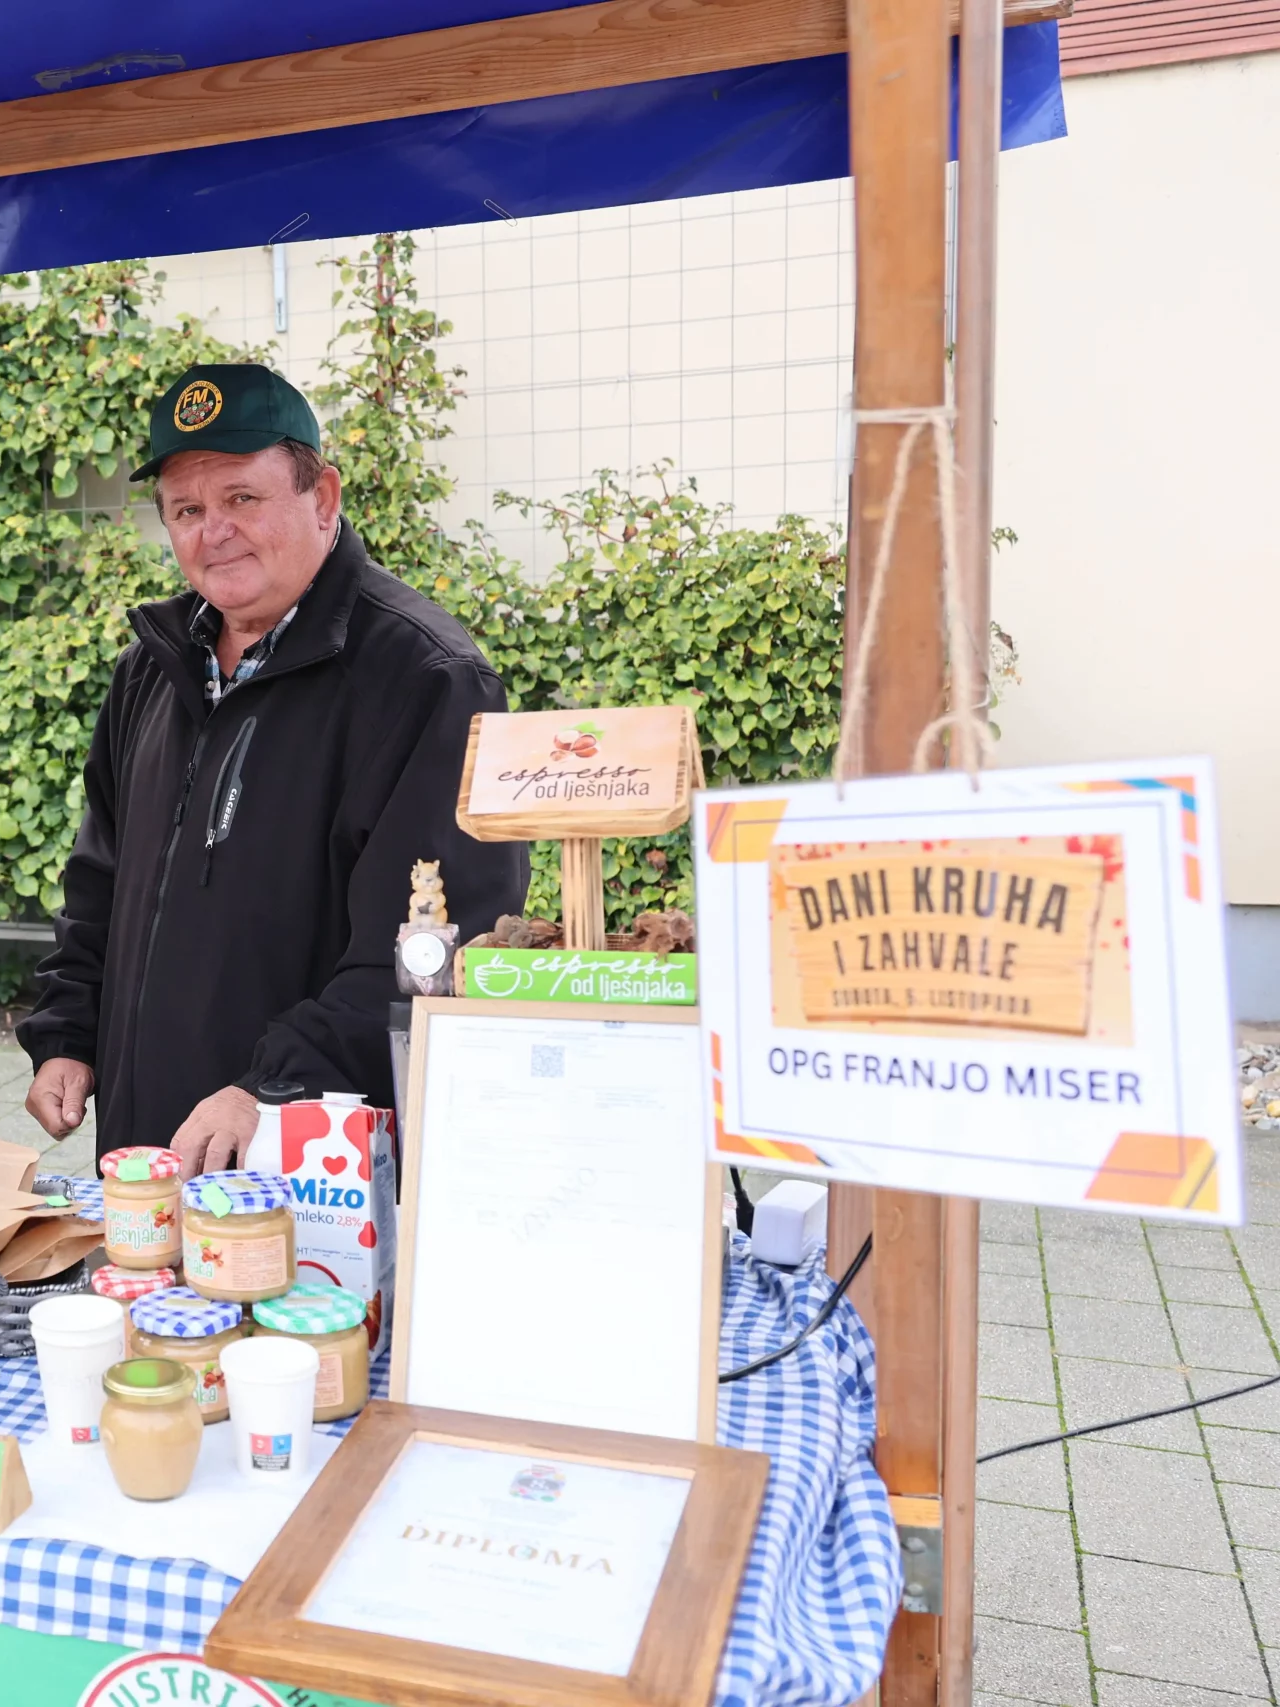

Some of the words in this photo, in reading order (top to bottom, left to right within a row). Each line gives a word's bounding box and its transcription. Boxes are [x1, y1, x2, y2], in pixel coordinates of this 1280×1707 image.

[182, 388, 209, 409] FM
[498, 766, 652, 800] espresso
[535, 781, 557, 799] od
[564, 779, 650, 801] lješnjaka
[798, 868, 890, 931] DANI
[913, 866, 1069, 934] KRUHA
[833, 939, 847, 975] I
[858, 930, 1020, 981] ZAHVALE
[531, 954, 686, 997] espresso
[571, 974, 594, 996] od
[599, 974, 686, 1002] lješnjaka
[929, 991, 1034, 1016] LISTOPADA
[768, 1046, 832, 1080] OPG
[844, 1053, 990, 1094] FRANJO
[1005, 1065, 1143, 1105] MISER
[290, 1177, 365, 1209] Mizo
[138, 1211, 150, 1222] od
[336, 1215, 363, 1228] 2,8%
[297, 1247, 309, 1256] HT
[399, 1524, 615, 1576] DIPLOMA
